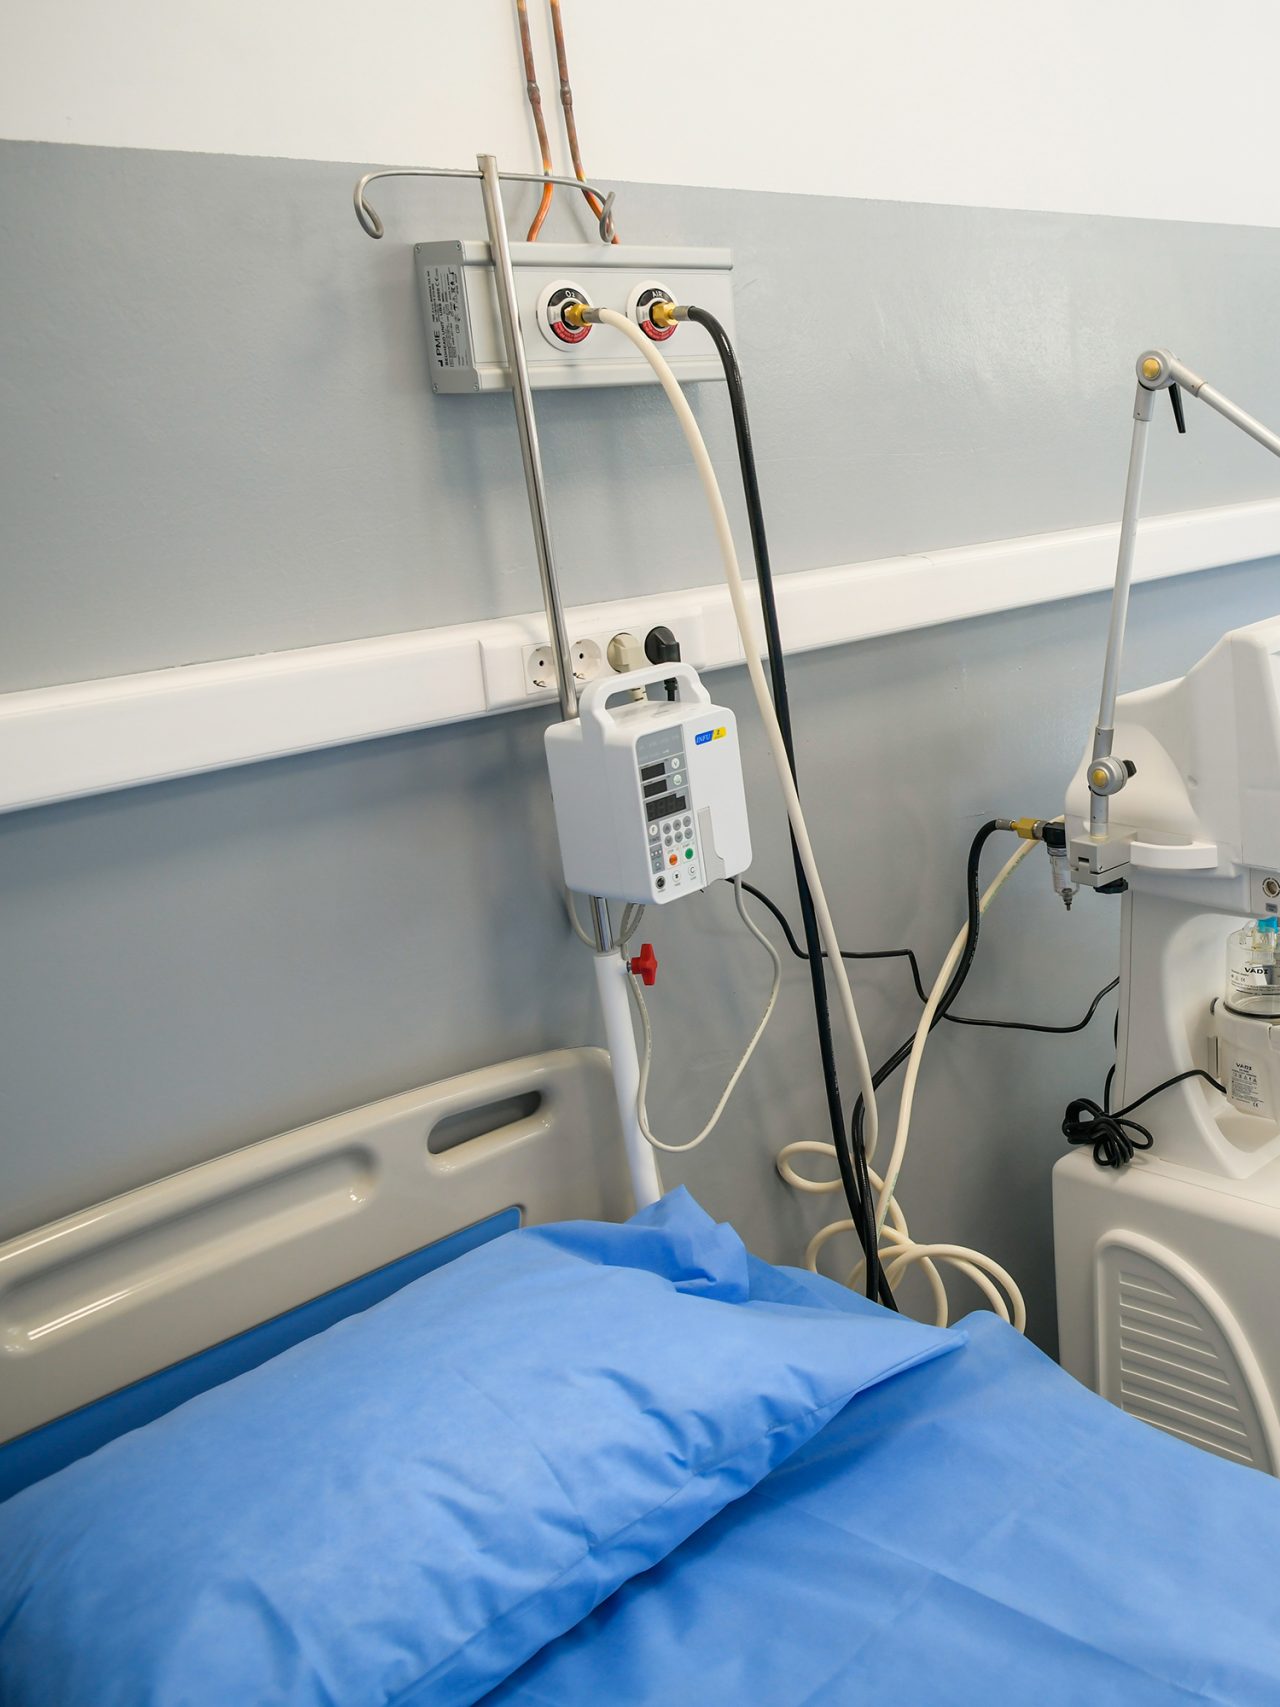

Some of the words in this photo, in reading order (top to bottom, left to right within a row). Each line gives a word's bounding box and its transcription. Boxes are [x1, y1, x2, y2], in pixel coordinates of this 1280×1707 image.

[434, 330, 442, 356] PME
[696, 734, 710, 744] INFU
[1236, 1062, 1252, 1070] VADI
